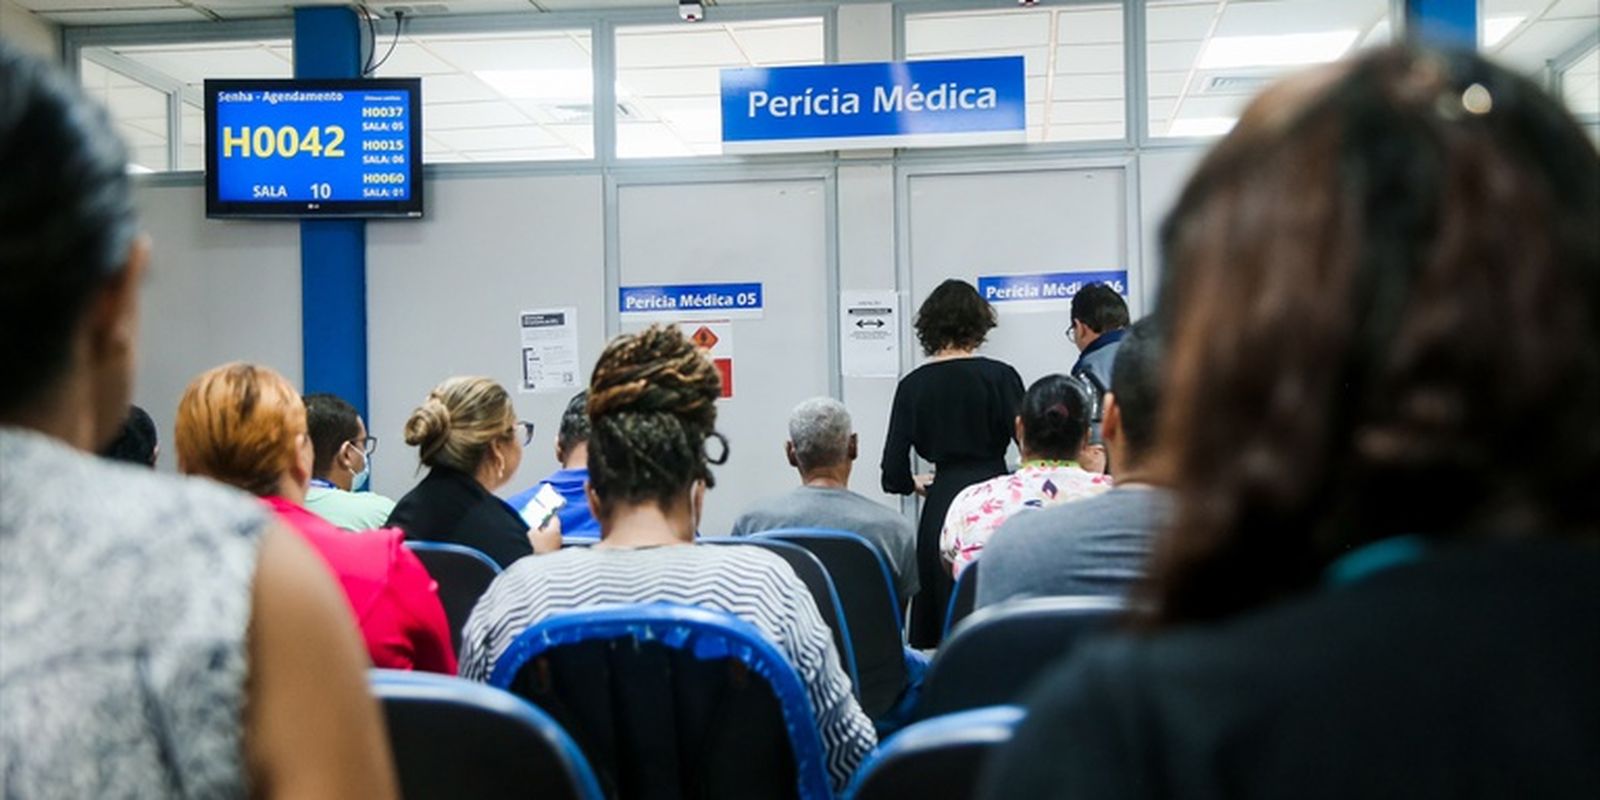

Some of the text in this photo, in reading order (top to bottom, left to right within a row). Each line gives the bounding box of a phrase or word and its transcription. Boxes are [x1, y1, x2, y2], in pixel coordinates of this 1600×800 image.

[218, 91, 253, 102] Senha
[262, 91, 344, 105] Agendamento
[748, 83, 997, 118] Perícia Médica
[362, 106, 404, 117] H0037
[223, 125, 345, 158] H0042
[362, 139, 404, 151] H0015
[363, 172, 405, 184] H0060
[253, 183, 331, 199] SALA 10
[679, 293, 734, 307] Médica
[736, 292, 757, 306] 05
